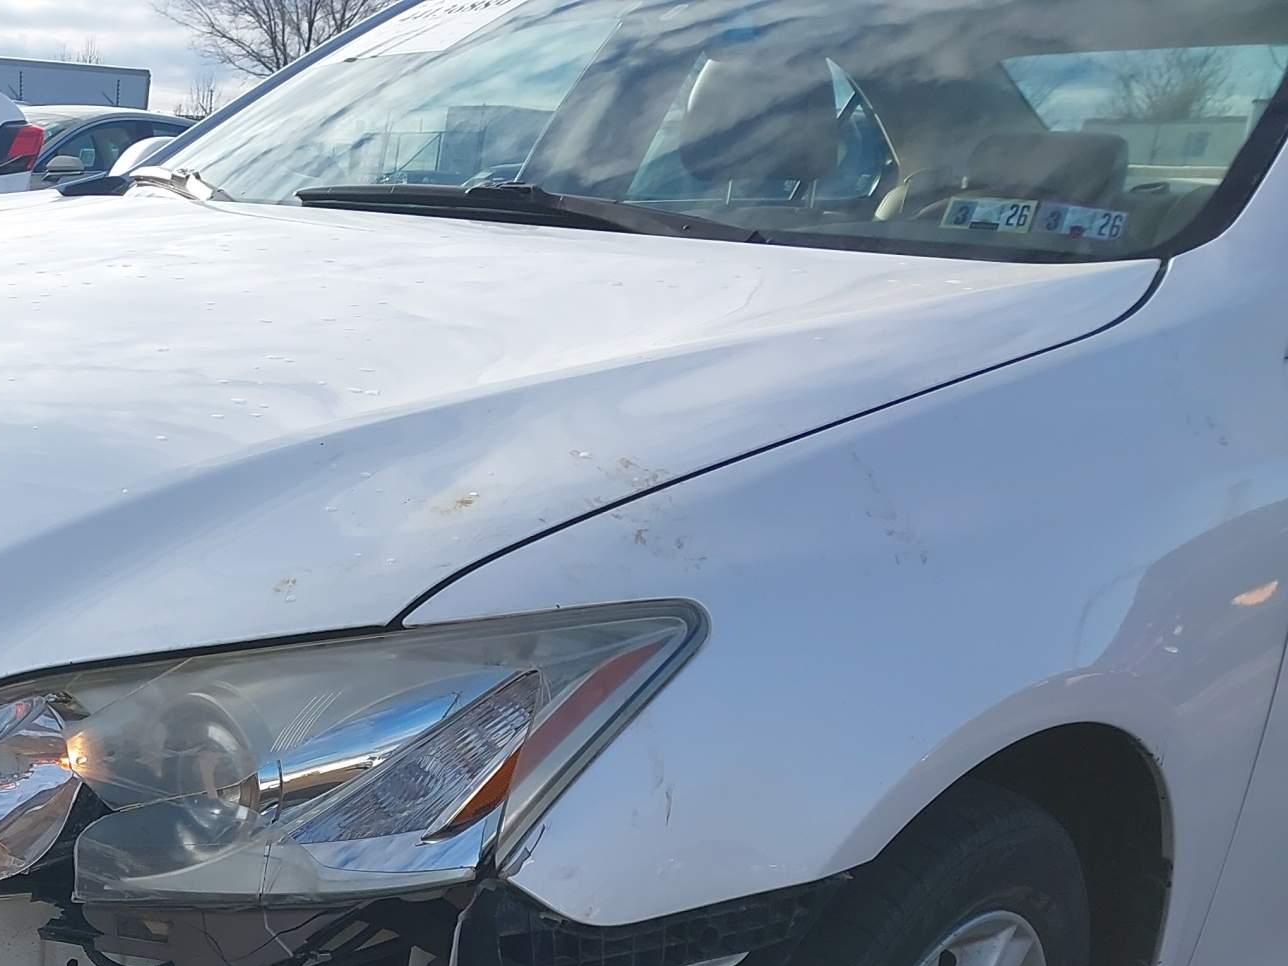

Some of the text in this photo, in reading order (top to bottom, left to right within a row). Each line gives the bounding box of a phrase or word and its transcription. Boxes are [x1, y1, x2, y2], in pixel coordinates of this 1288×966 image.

[952, 203, 1031, 227] 3 26
[1046, 210, 1123, 238] 3 26
